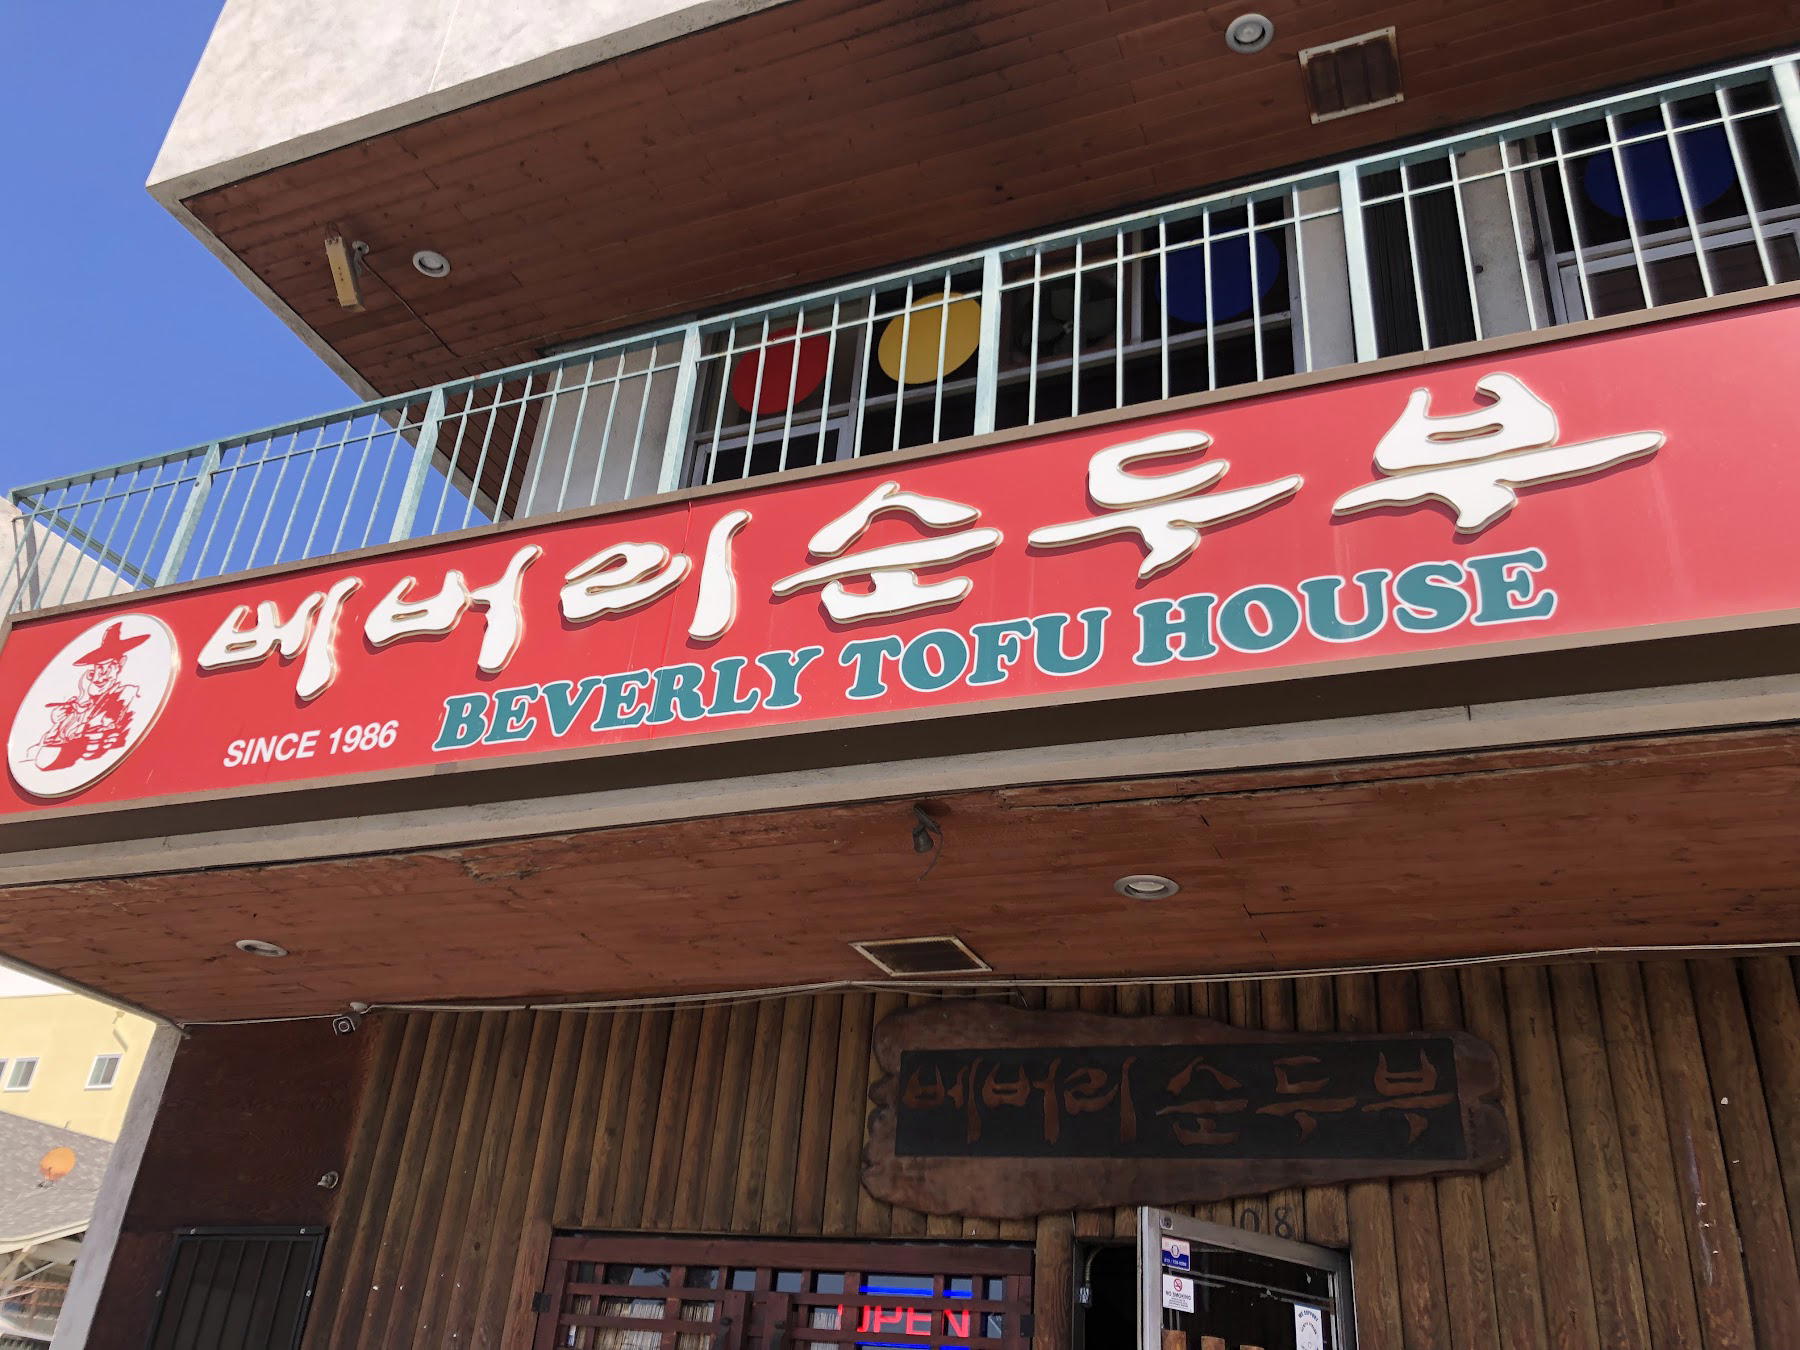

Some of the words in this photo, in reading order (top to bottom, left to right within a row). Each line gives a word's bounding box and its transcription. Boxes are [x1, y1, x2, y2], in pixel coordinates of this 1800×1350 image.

[431, 644, 823, 752] BEVERLY
[839, 608, 1111, 701] TOFU
[1133, 548, 1558, 666] HOUSE
[223, 730, 321, 767] SINCE
[329, 719, 400, 754] 1986
